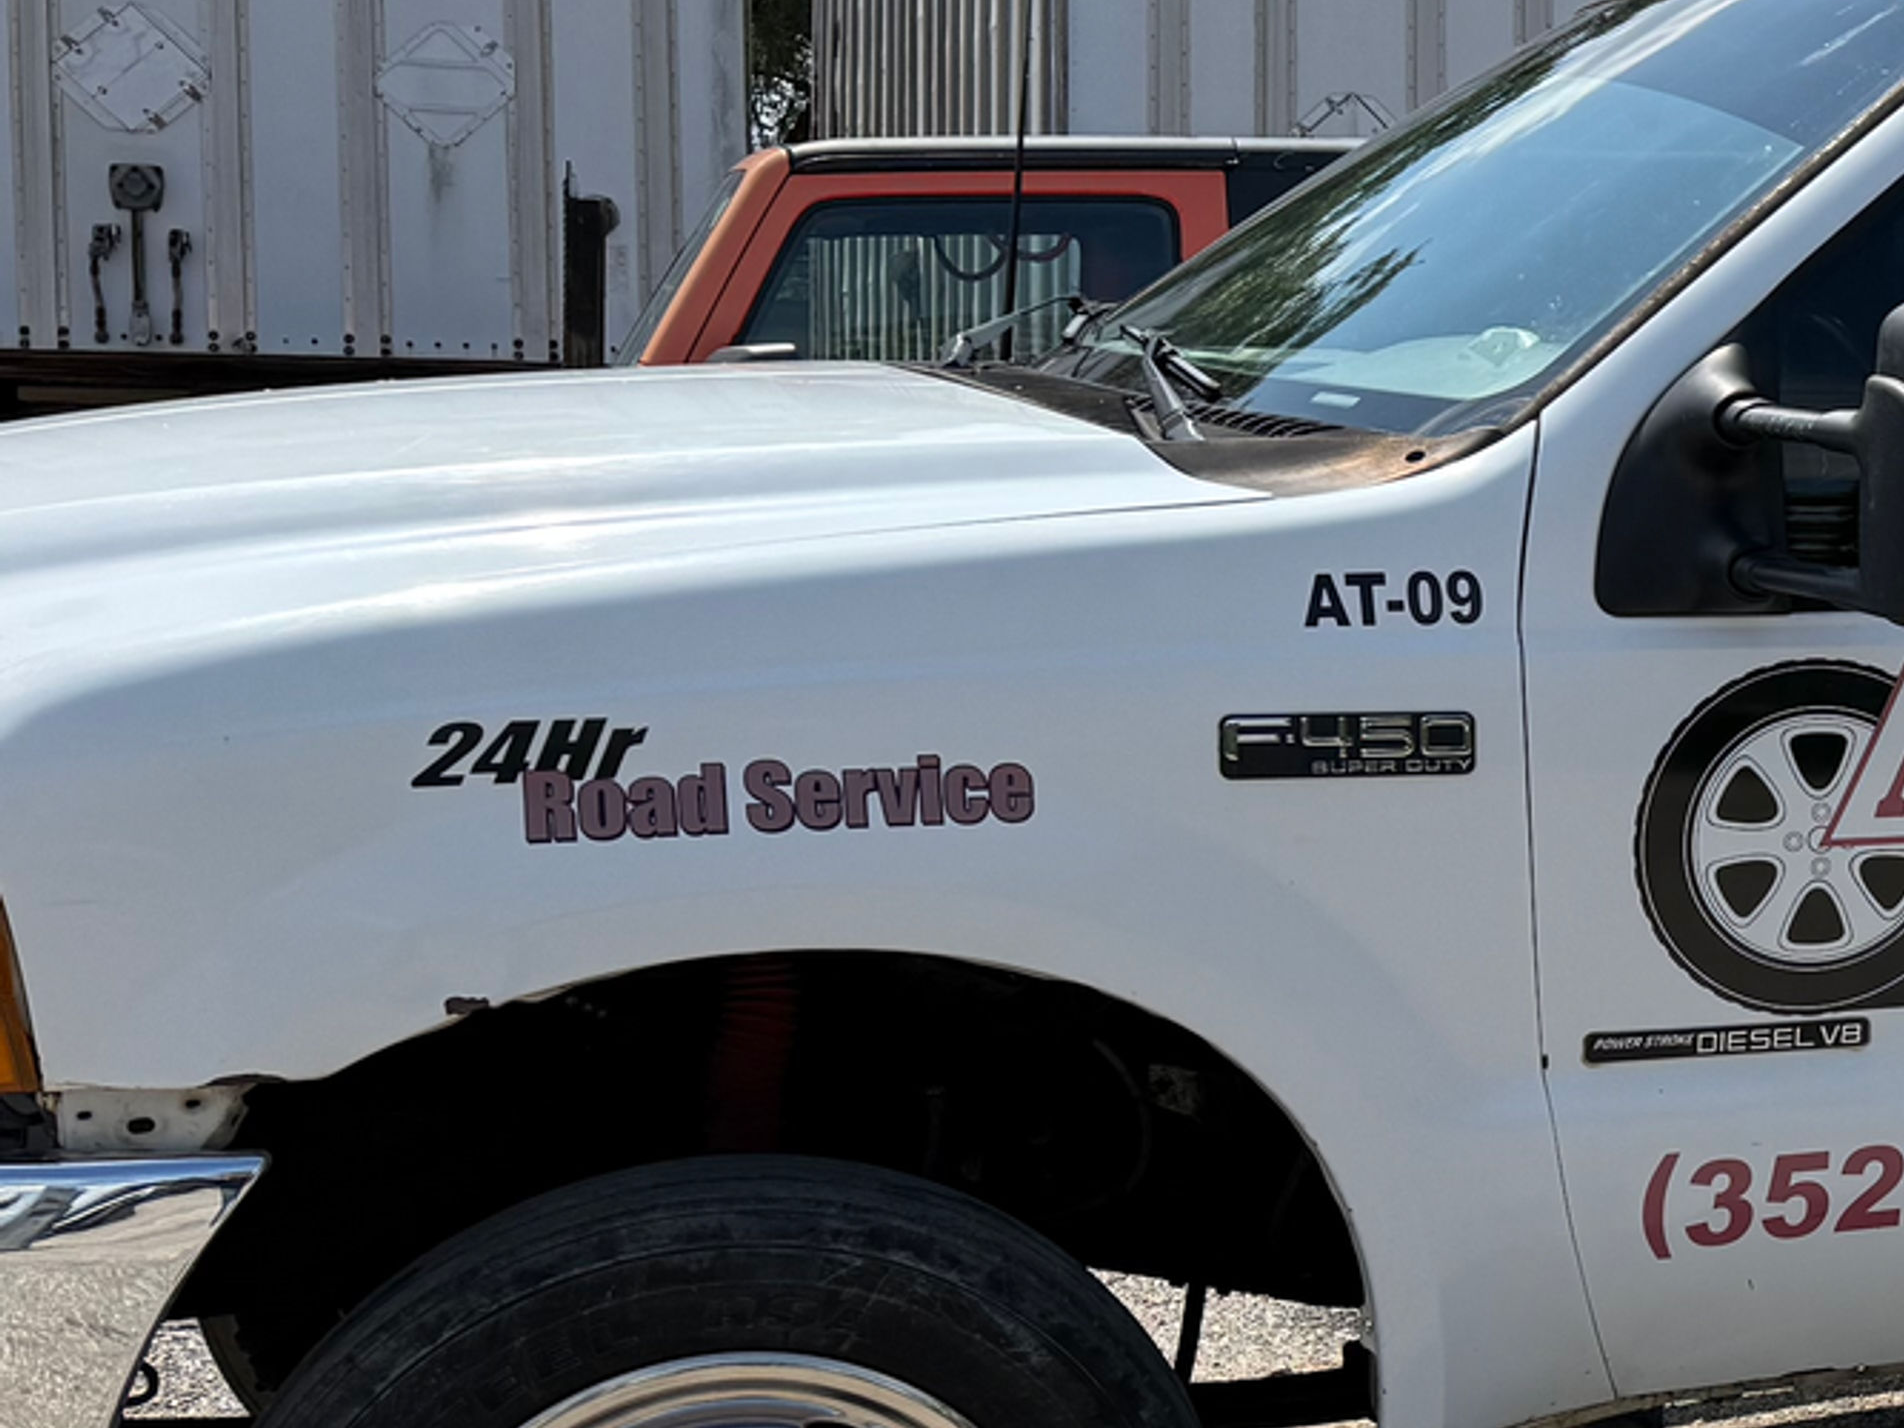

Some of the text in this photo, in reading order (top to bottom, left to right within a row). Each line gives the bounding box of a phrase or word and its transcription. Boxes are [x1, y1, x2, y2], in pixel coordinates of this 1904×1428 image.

[1304, 569, 1483, 628] AT-09
[410, 717, 649, 789] 24Hr
[1223, 714, 1473, 762] F-450
[1311, 758, 1472, 775] SUPER DUTY
[521, 754, 1035, 844] Road Service
[1696, 1026, 1815, 1054] DIESEL
[1819, 1023, 1862, 1047] V8
